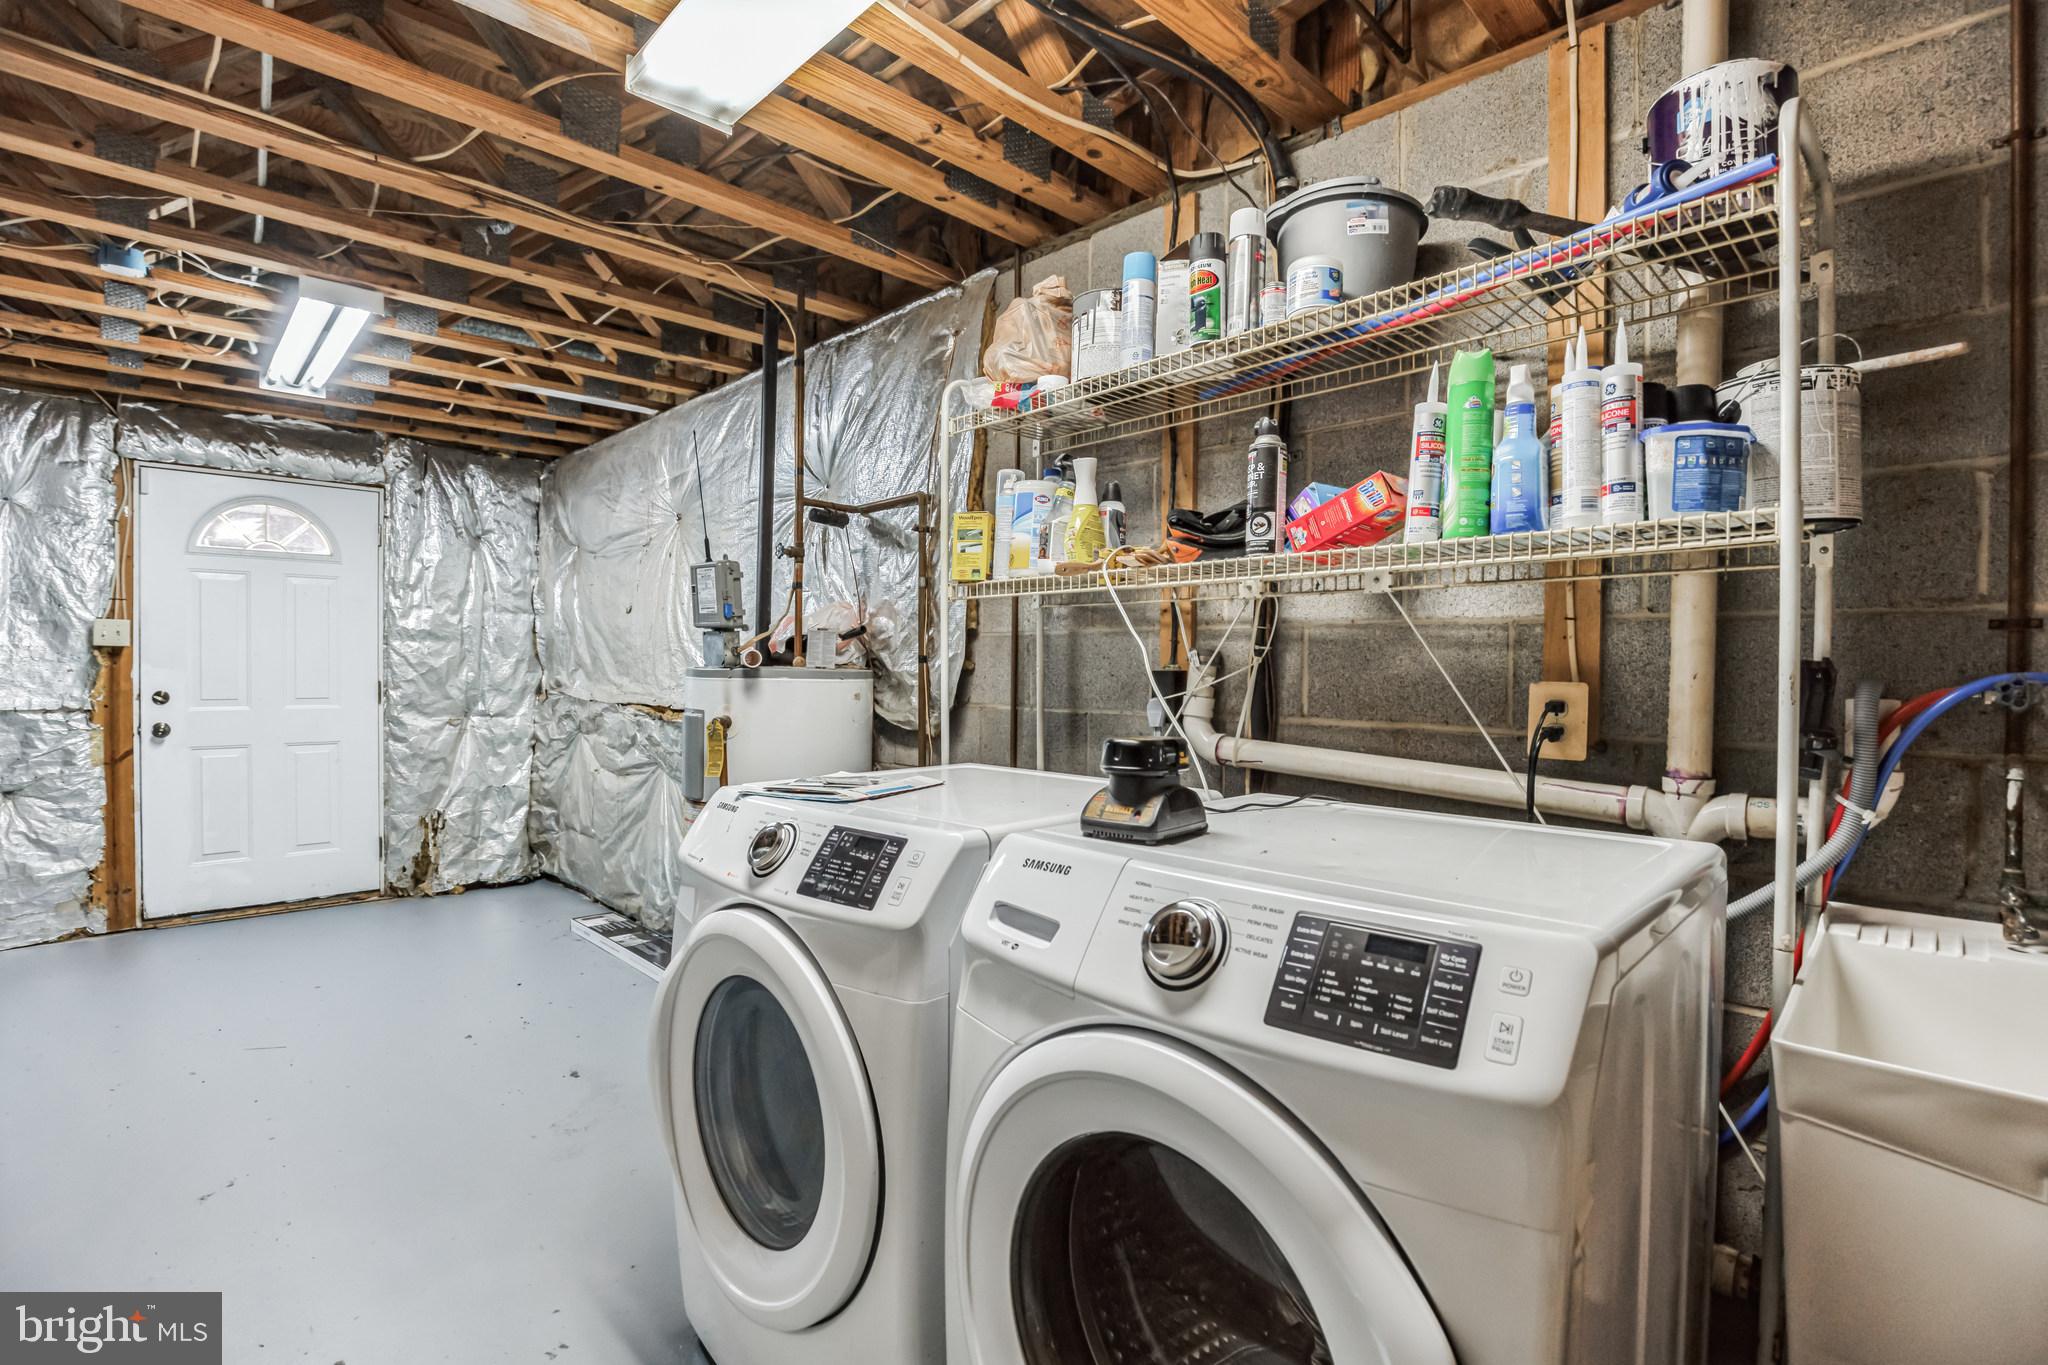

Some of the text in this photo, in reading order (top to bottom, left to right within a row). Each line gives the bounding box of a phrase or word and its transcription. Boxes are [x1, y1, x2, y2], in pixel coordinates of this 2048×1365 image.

[1197, 276, 1214, 284] Heat
[717, 801, 739, 812] SAMSUNG
[1023, 858, 1071, 875] SAMSUNG
